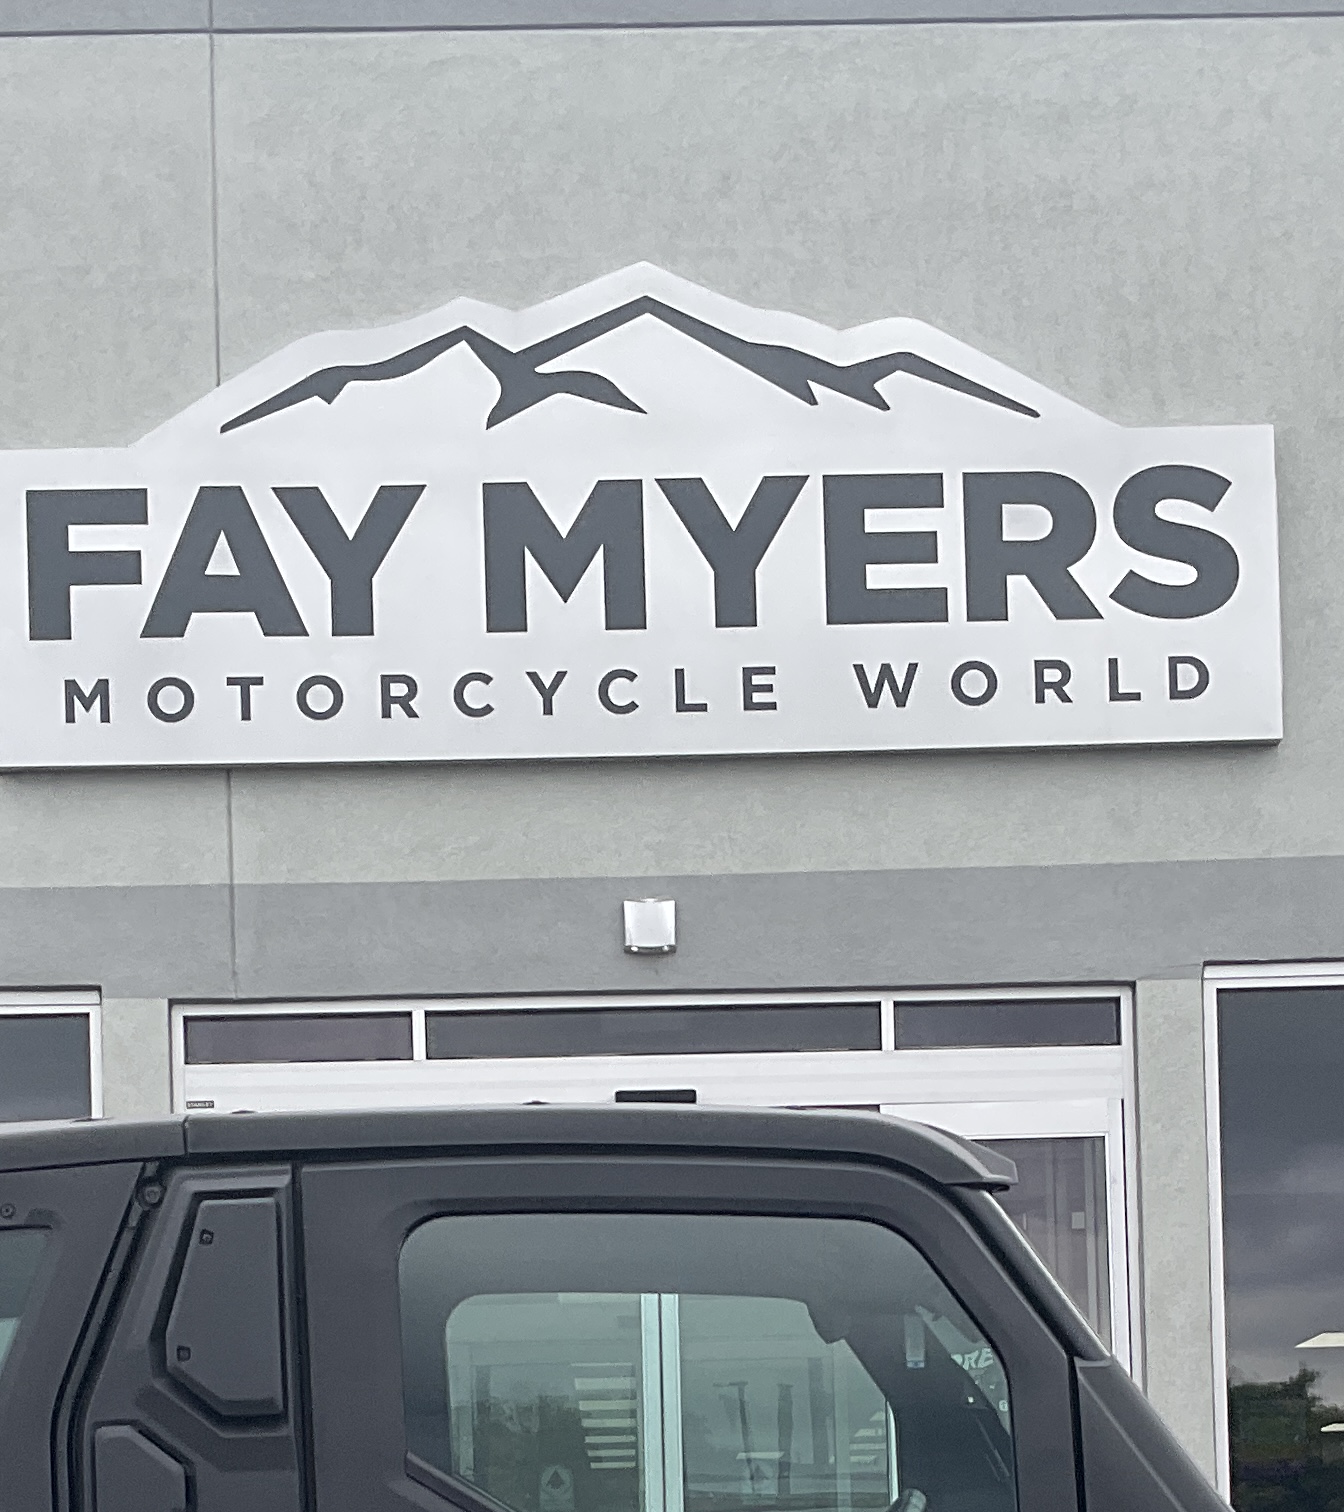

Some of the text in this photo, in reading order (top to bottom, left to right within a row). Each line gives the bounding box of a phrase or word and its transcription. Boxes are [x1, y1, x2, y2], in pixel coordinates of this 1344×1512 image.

[25, 464, 1241, 641] FAY MYERS
[64, 654, 1211, 724] MOTORCYCLE WORLD
